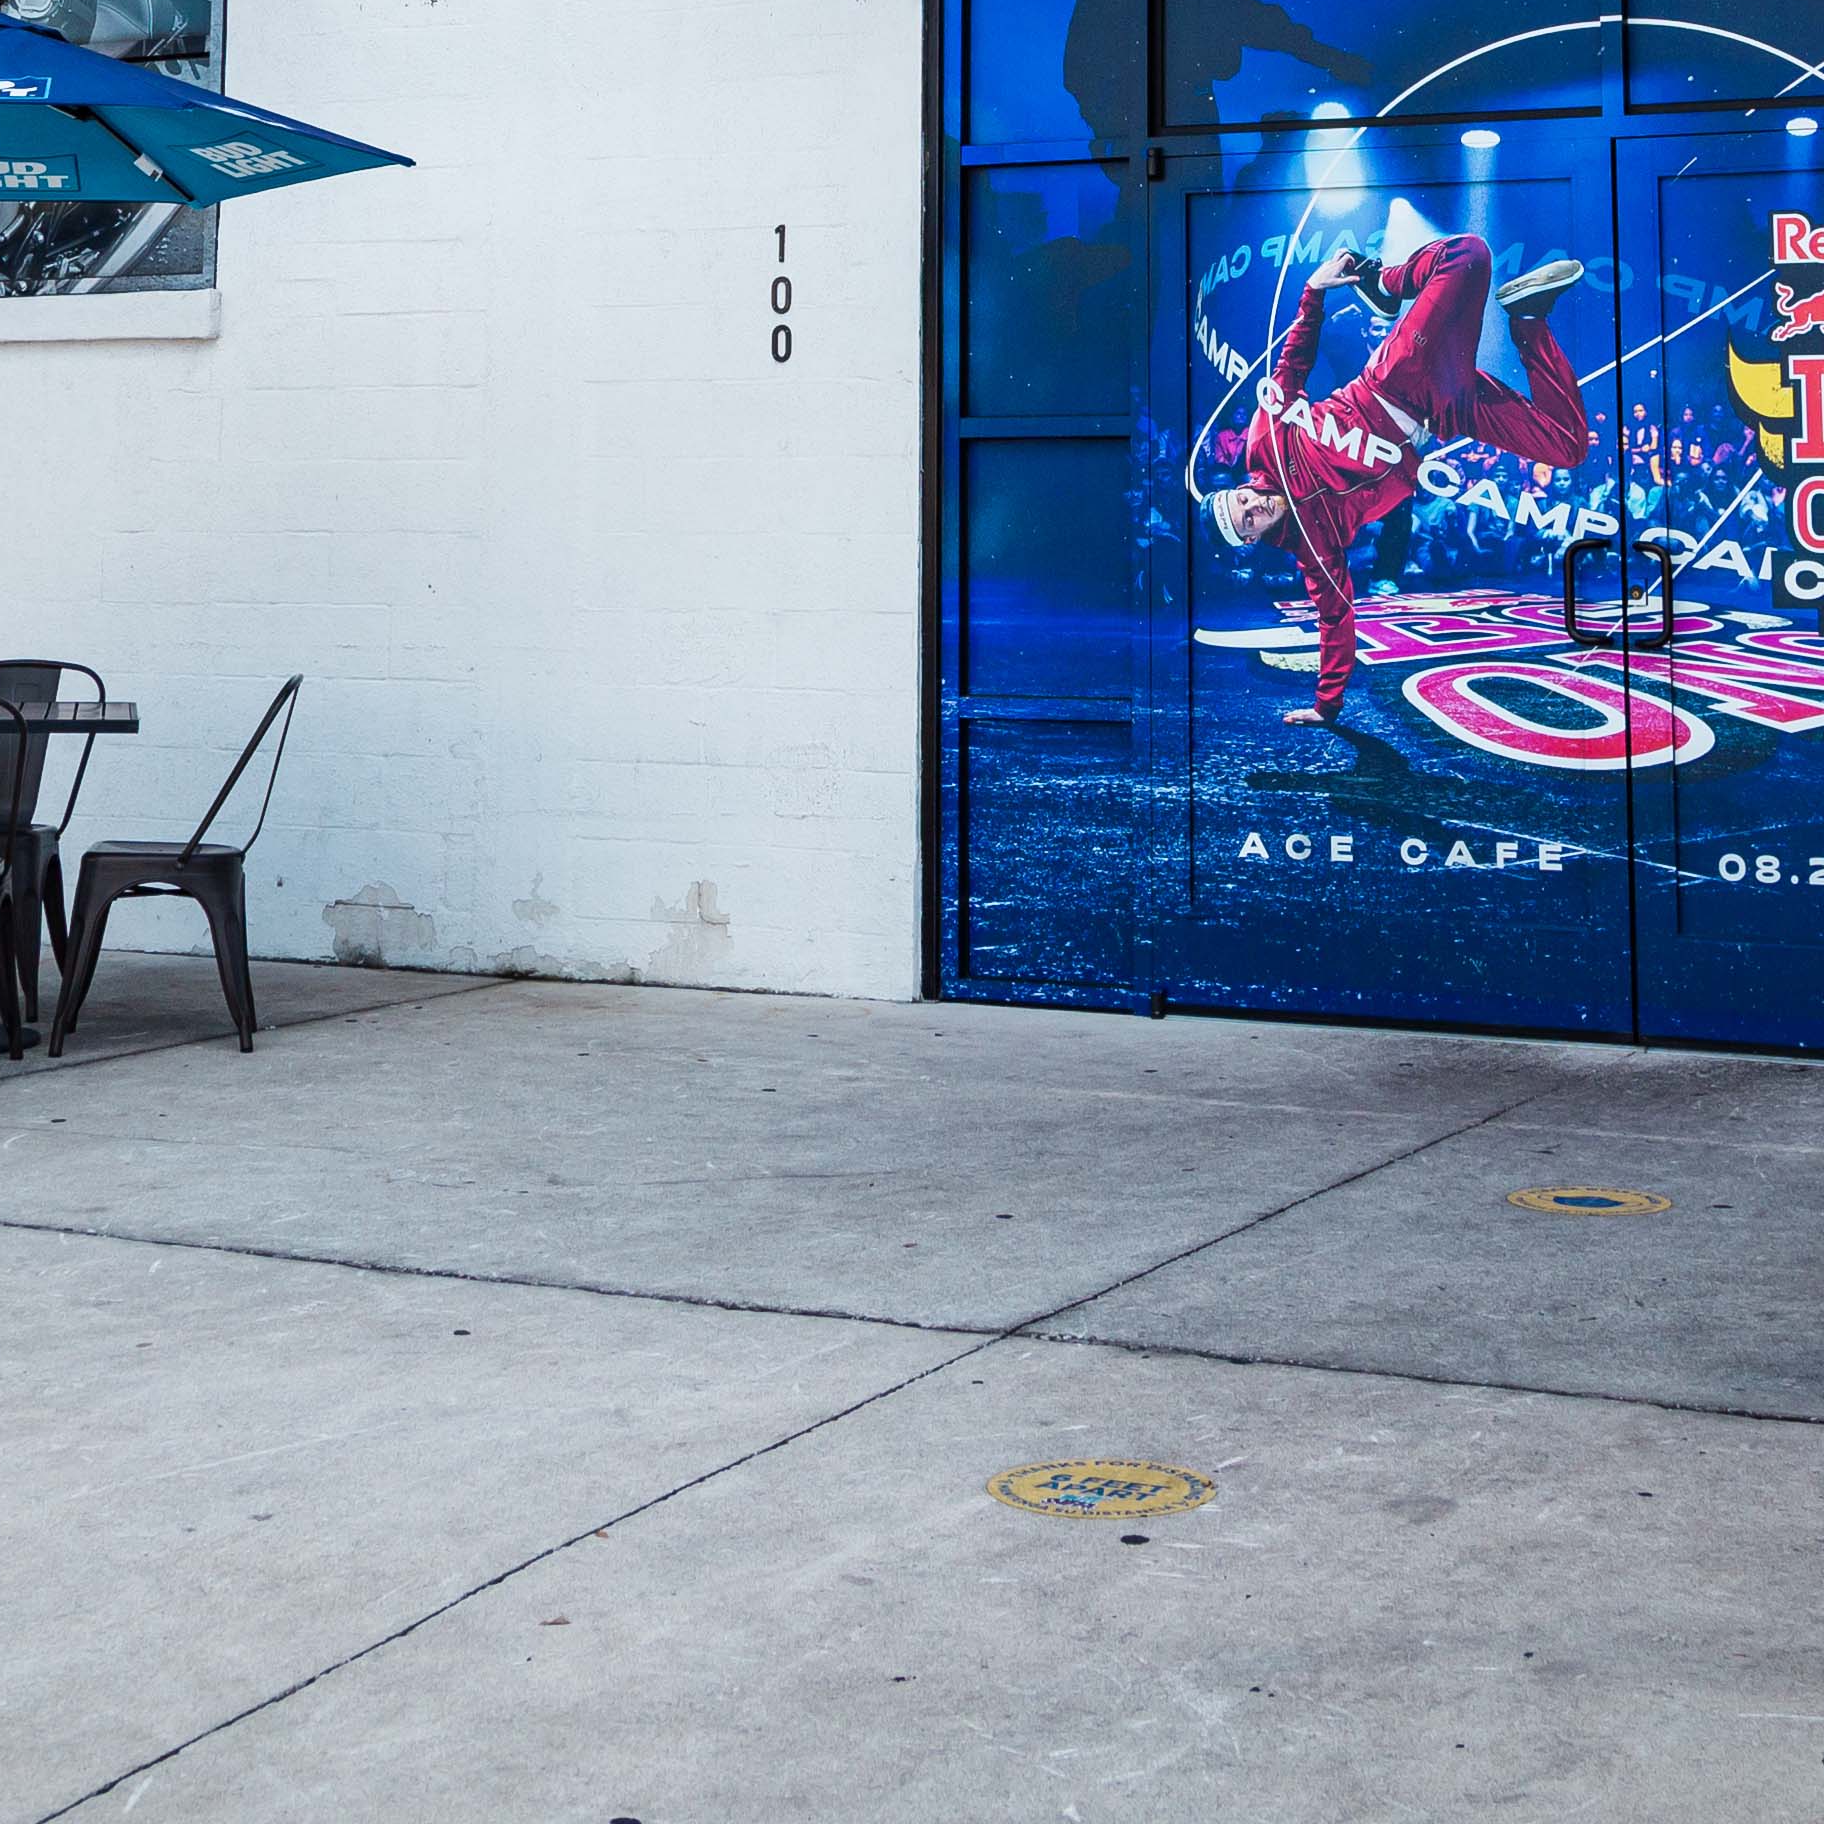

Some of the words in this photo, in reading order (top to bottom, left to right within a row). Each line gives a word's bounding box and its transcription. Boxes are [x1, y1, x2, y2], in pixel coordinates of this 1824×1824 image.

[189, 141, 263, 163] BUD
[210, 150, 306, 178] LIGHT
[1256, 377, 1403, 469] CAMP
[1417, 460, 1620, 539] CAMP
[1238, 832, 1354, 862] ACE
[1400, 837, 1565, 872] CAFE
[1034, 1482, 1157, 1500] APART
[1051, 1474, 1072, 1482] 6
[1080, 1477, 1172, 1493] FEET
